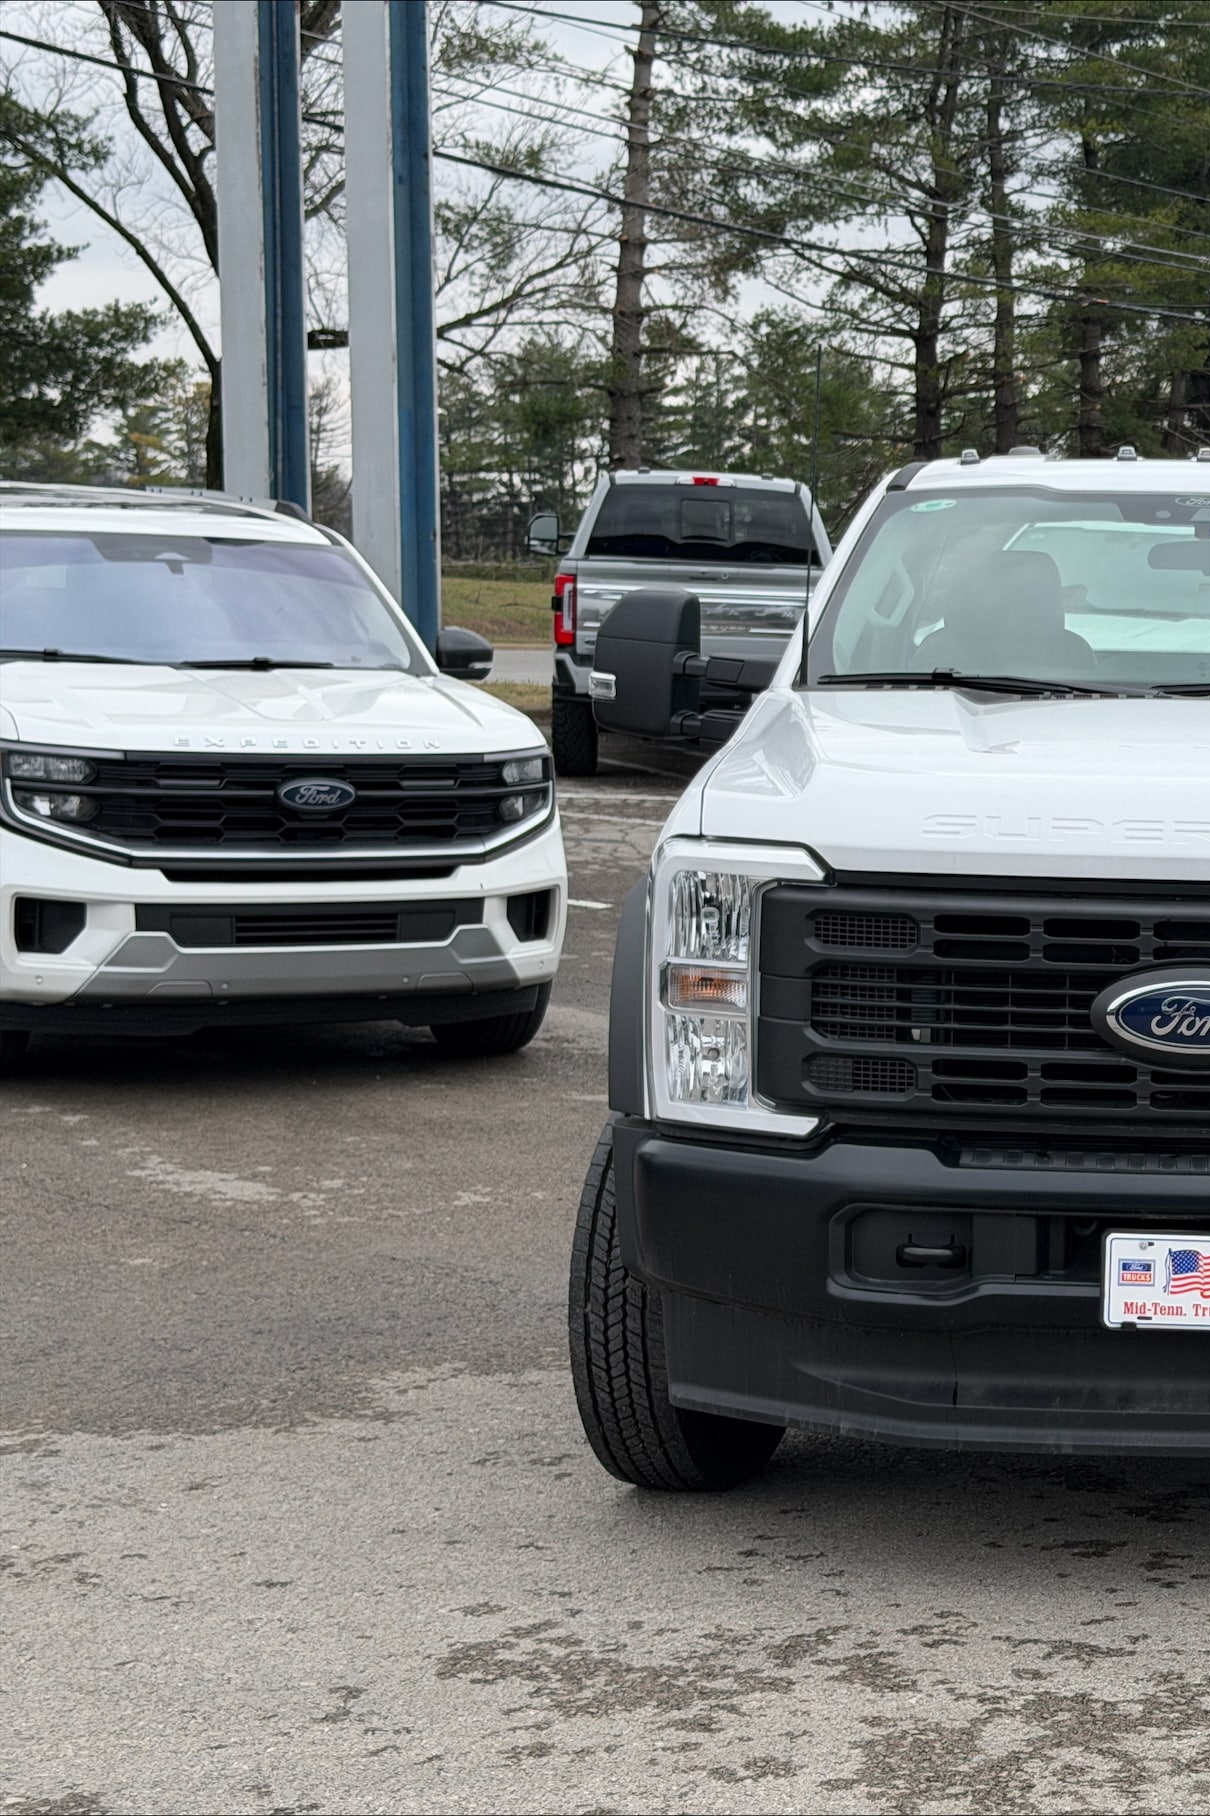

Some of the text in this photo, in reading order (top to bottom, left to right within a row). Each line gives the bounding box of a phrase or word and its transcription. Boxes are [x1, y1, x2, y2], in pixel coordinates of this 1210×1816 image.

[173, 735, 441, 749] EXPEDITION
[294, 785, 341, 806] Ford
[1122, 1272, 1151, 1282] TRUCKS
[1122, 1300, 1188, 1318] Mid-Tenn.
